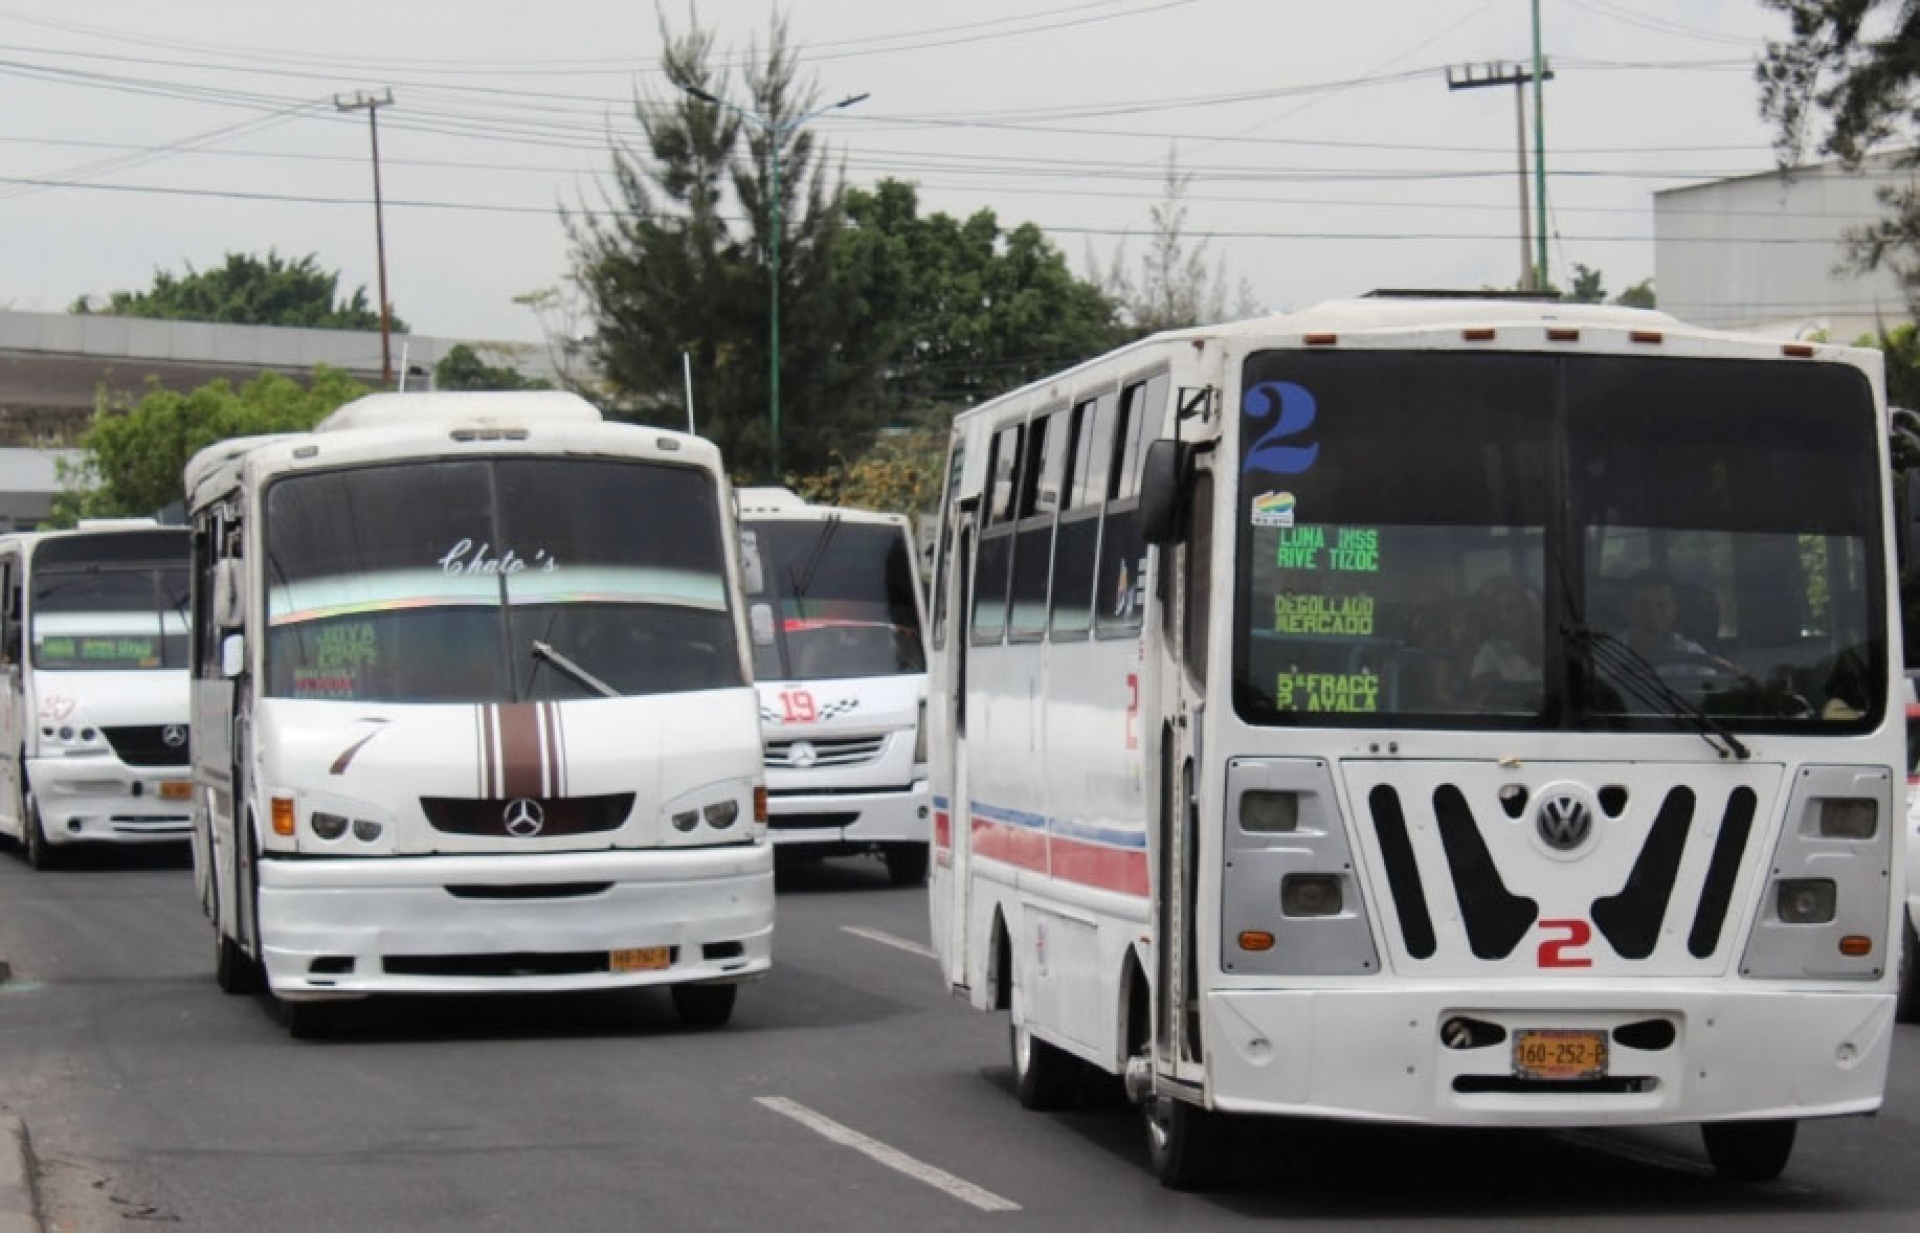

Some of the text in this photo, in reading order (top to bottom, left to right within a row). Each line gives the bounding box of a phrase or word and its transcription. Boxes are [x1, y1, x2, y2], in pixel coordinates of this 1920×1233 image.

[1243, 380, 1319, 474] 2
[1279, 526, 1379, 549] LUNA IMSS
[1277, 548, 1379, 570] RIVE TIZOC
[1275, 614, 1374, 635] MERCADO
[778, 690, 816, 724] 19
[1306, 692, 1377, 712] AYALA
[329, 717, 391, 775] 7
[1538, 918, 1593, 968] 2
